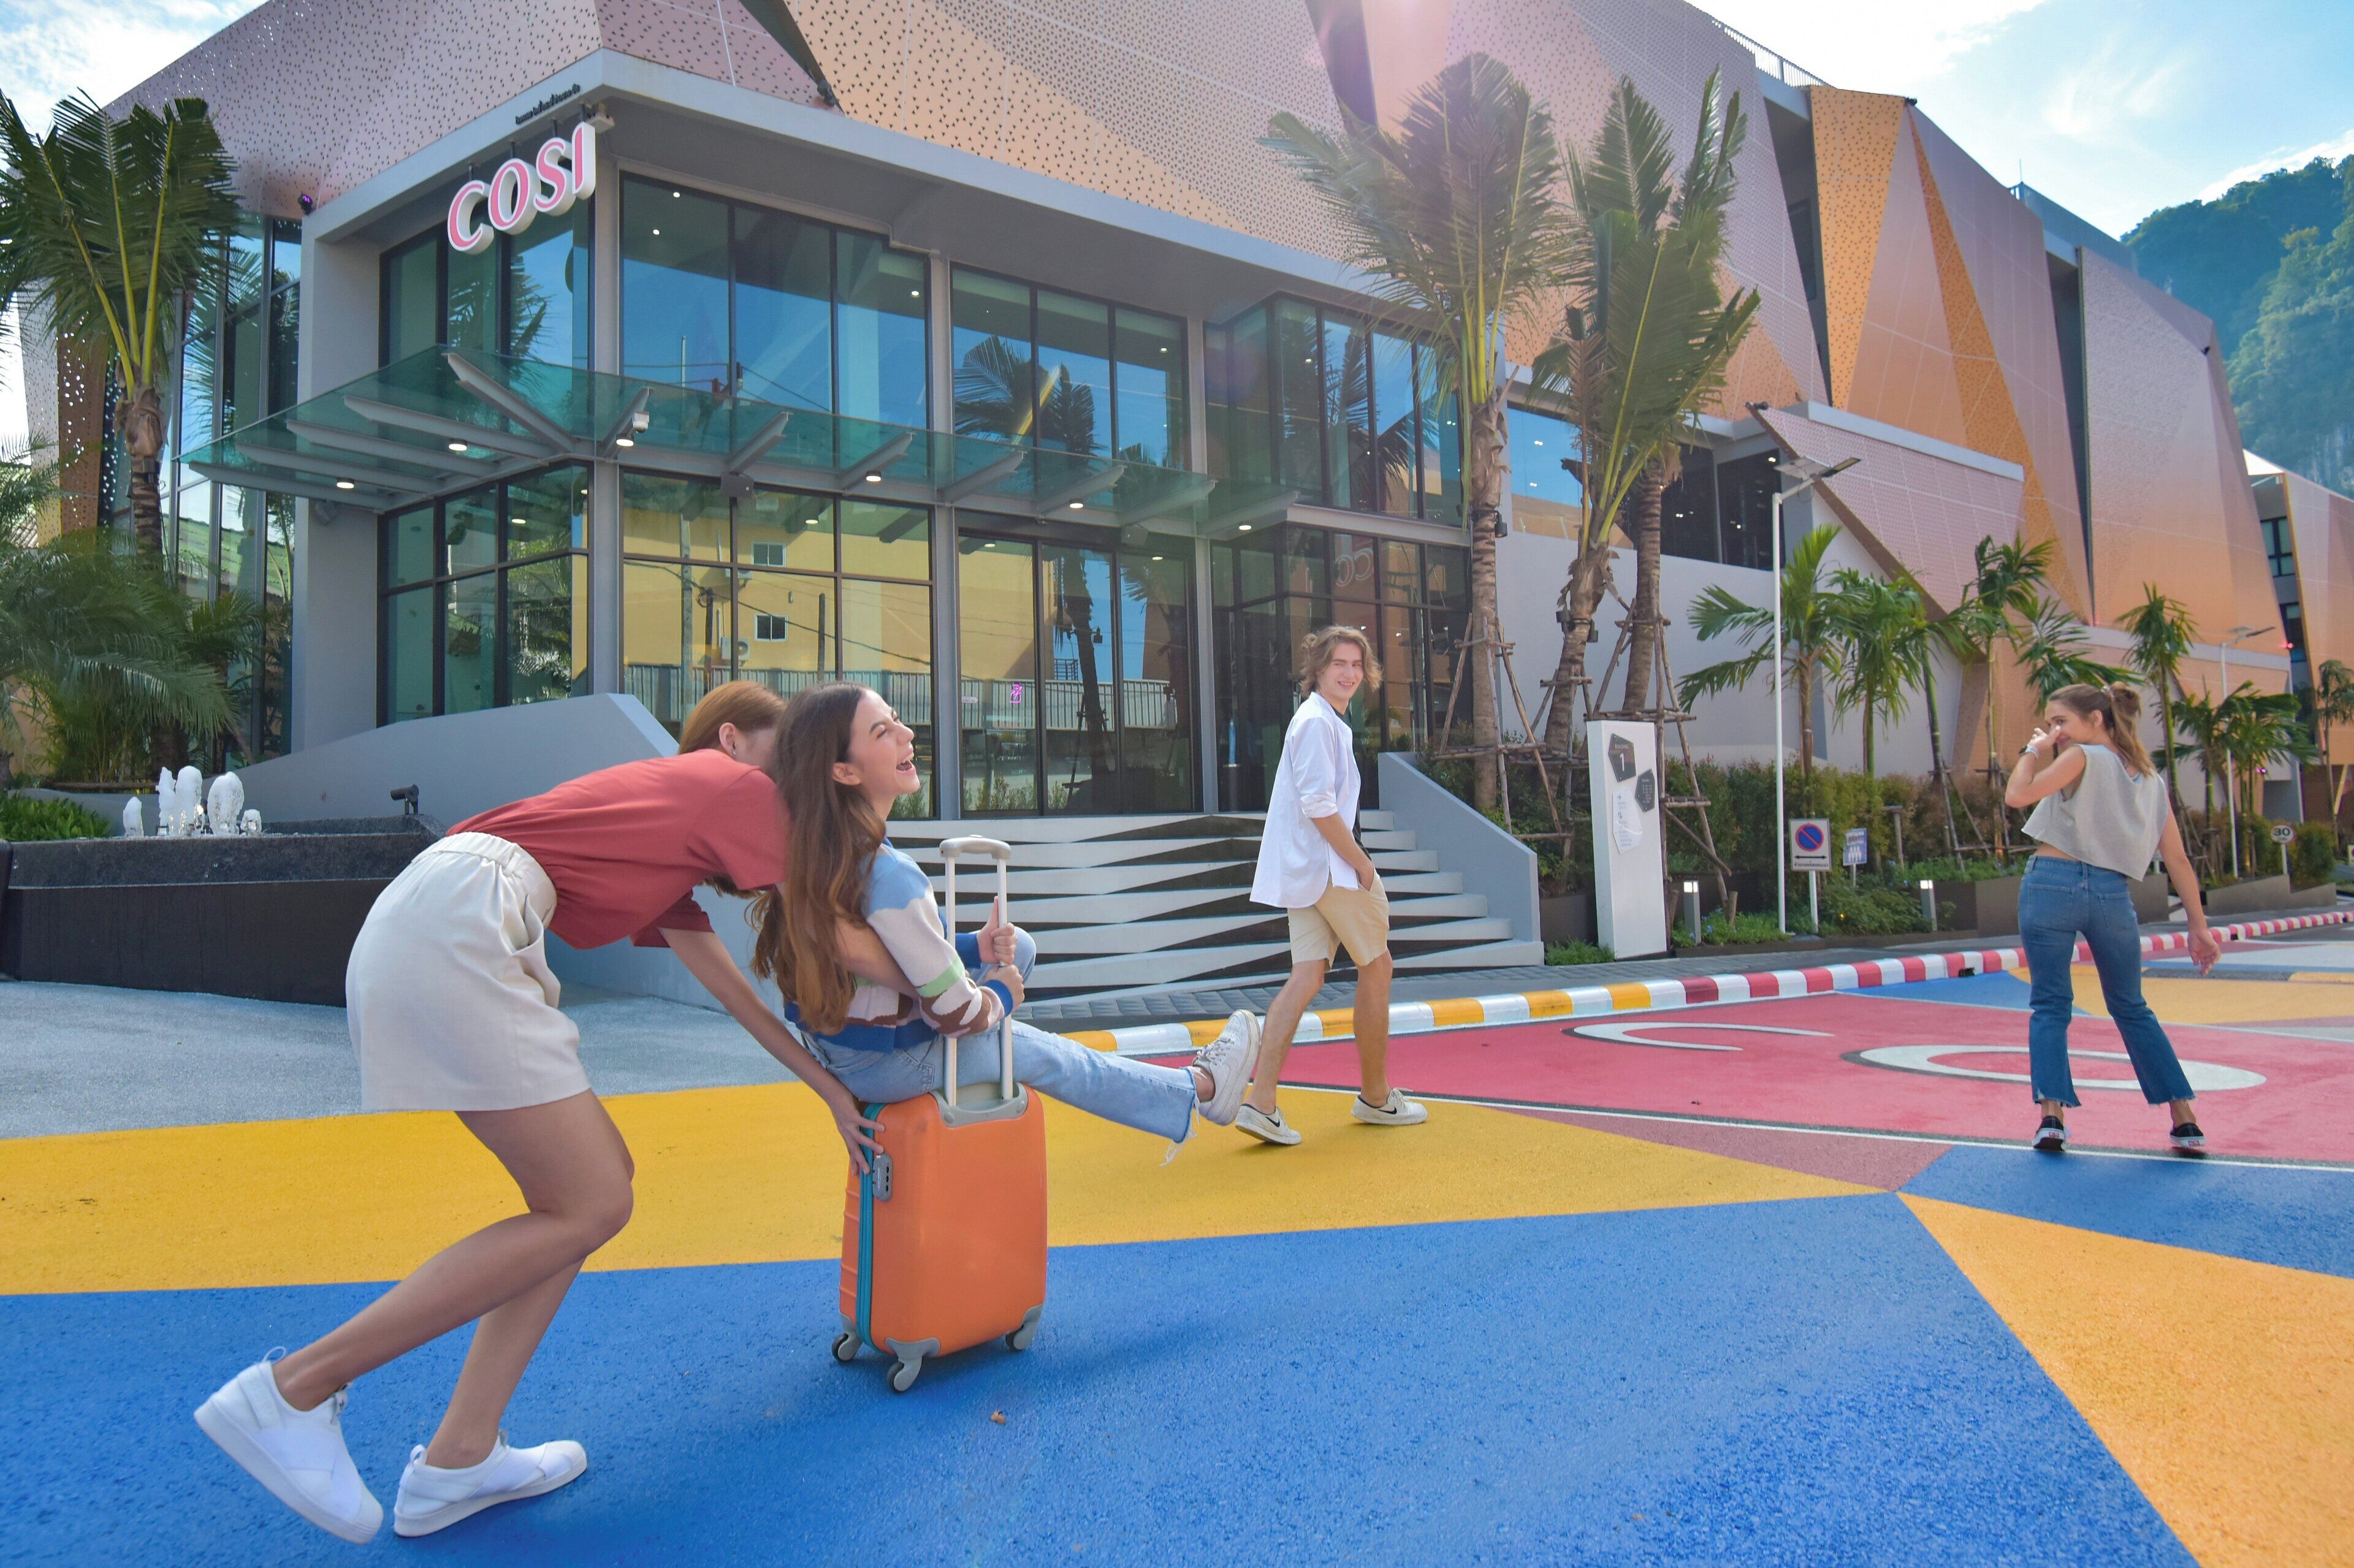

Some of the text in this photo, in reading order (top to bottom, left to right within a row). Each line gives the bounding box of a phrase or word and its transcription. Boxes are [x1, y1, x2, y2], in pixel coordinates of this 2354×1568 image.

[448, 121, 595, 254] COSI
[1620, 753, 1625, 772] 1
[2273, 828, 2290, 836] 30
